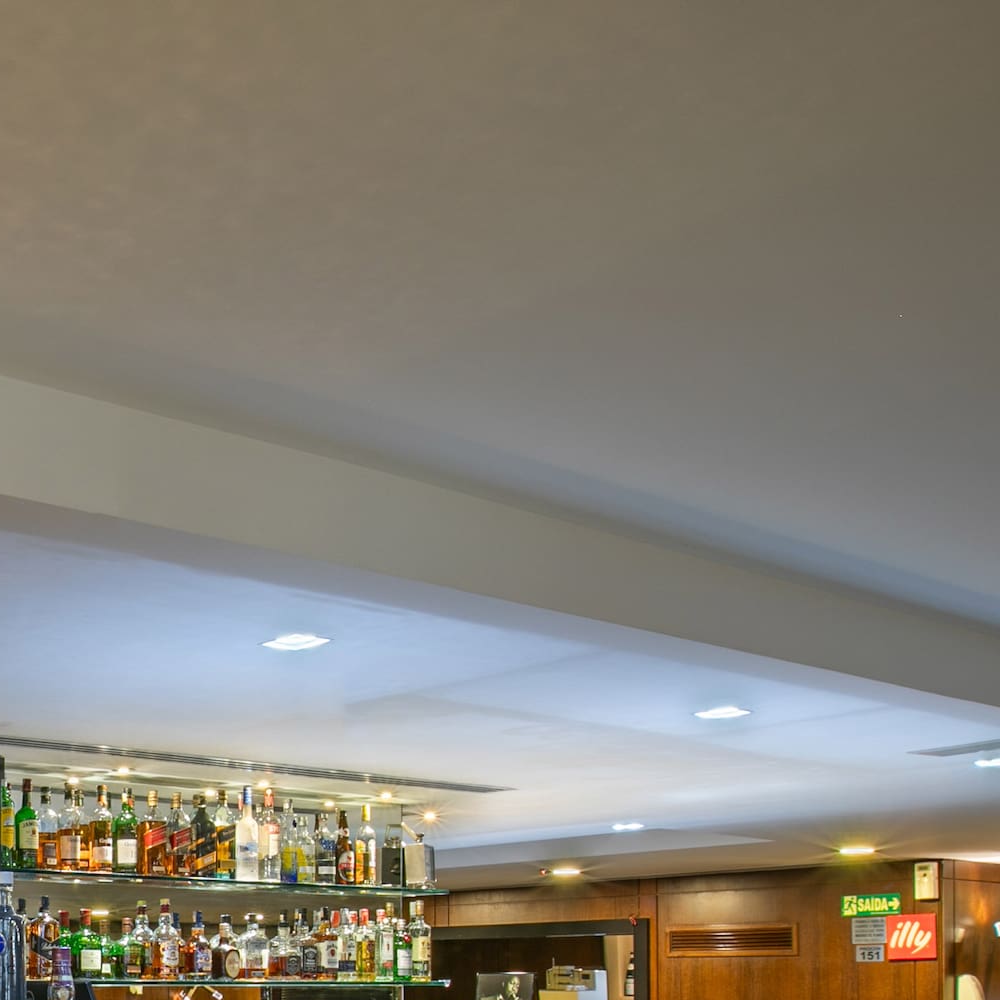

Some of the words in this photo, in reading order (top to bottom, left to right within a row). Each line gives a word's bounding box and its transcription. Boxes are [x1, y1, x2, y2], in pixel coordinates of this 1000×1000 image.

[858, 897, 888, 911] SAÍDA
[890, 921, 932, 954] illy
[860, 951, 880, 961] 151
